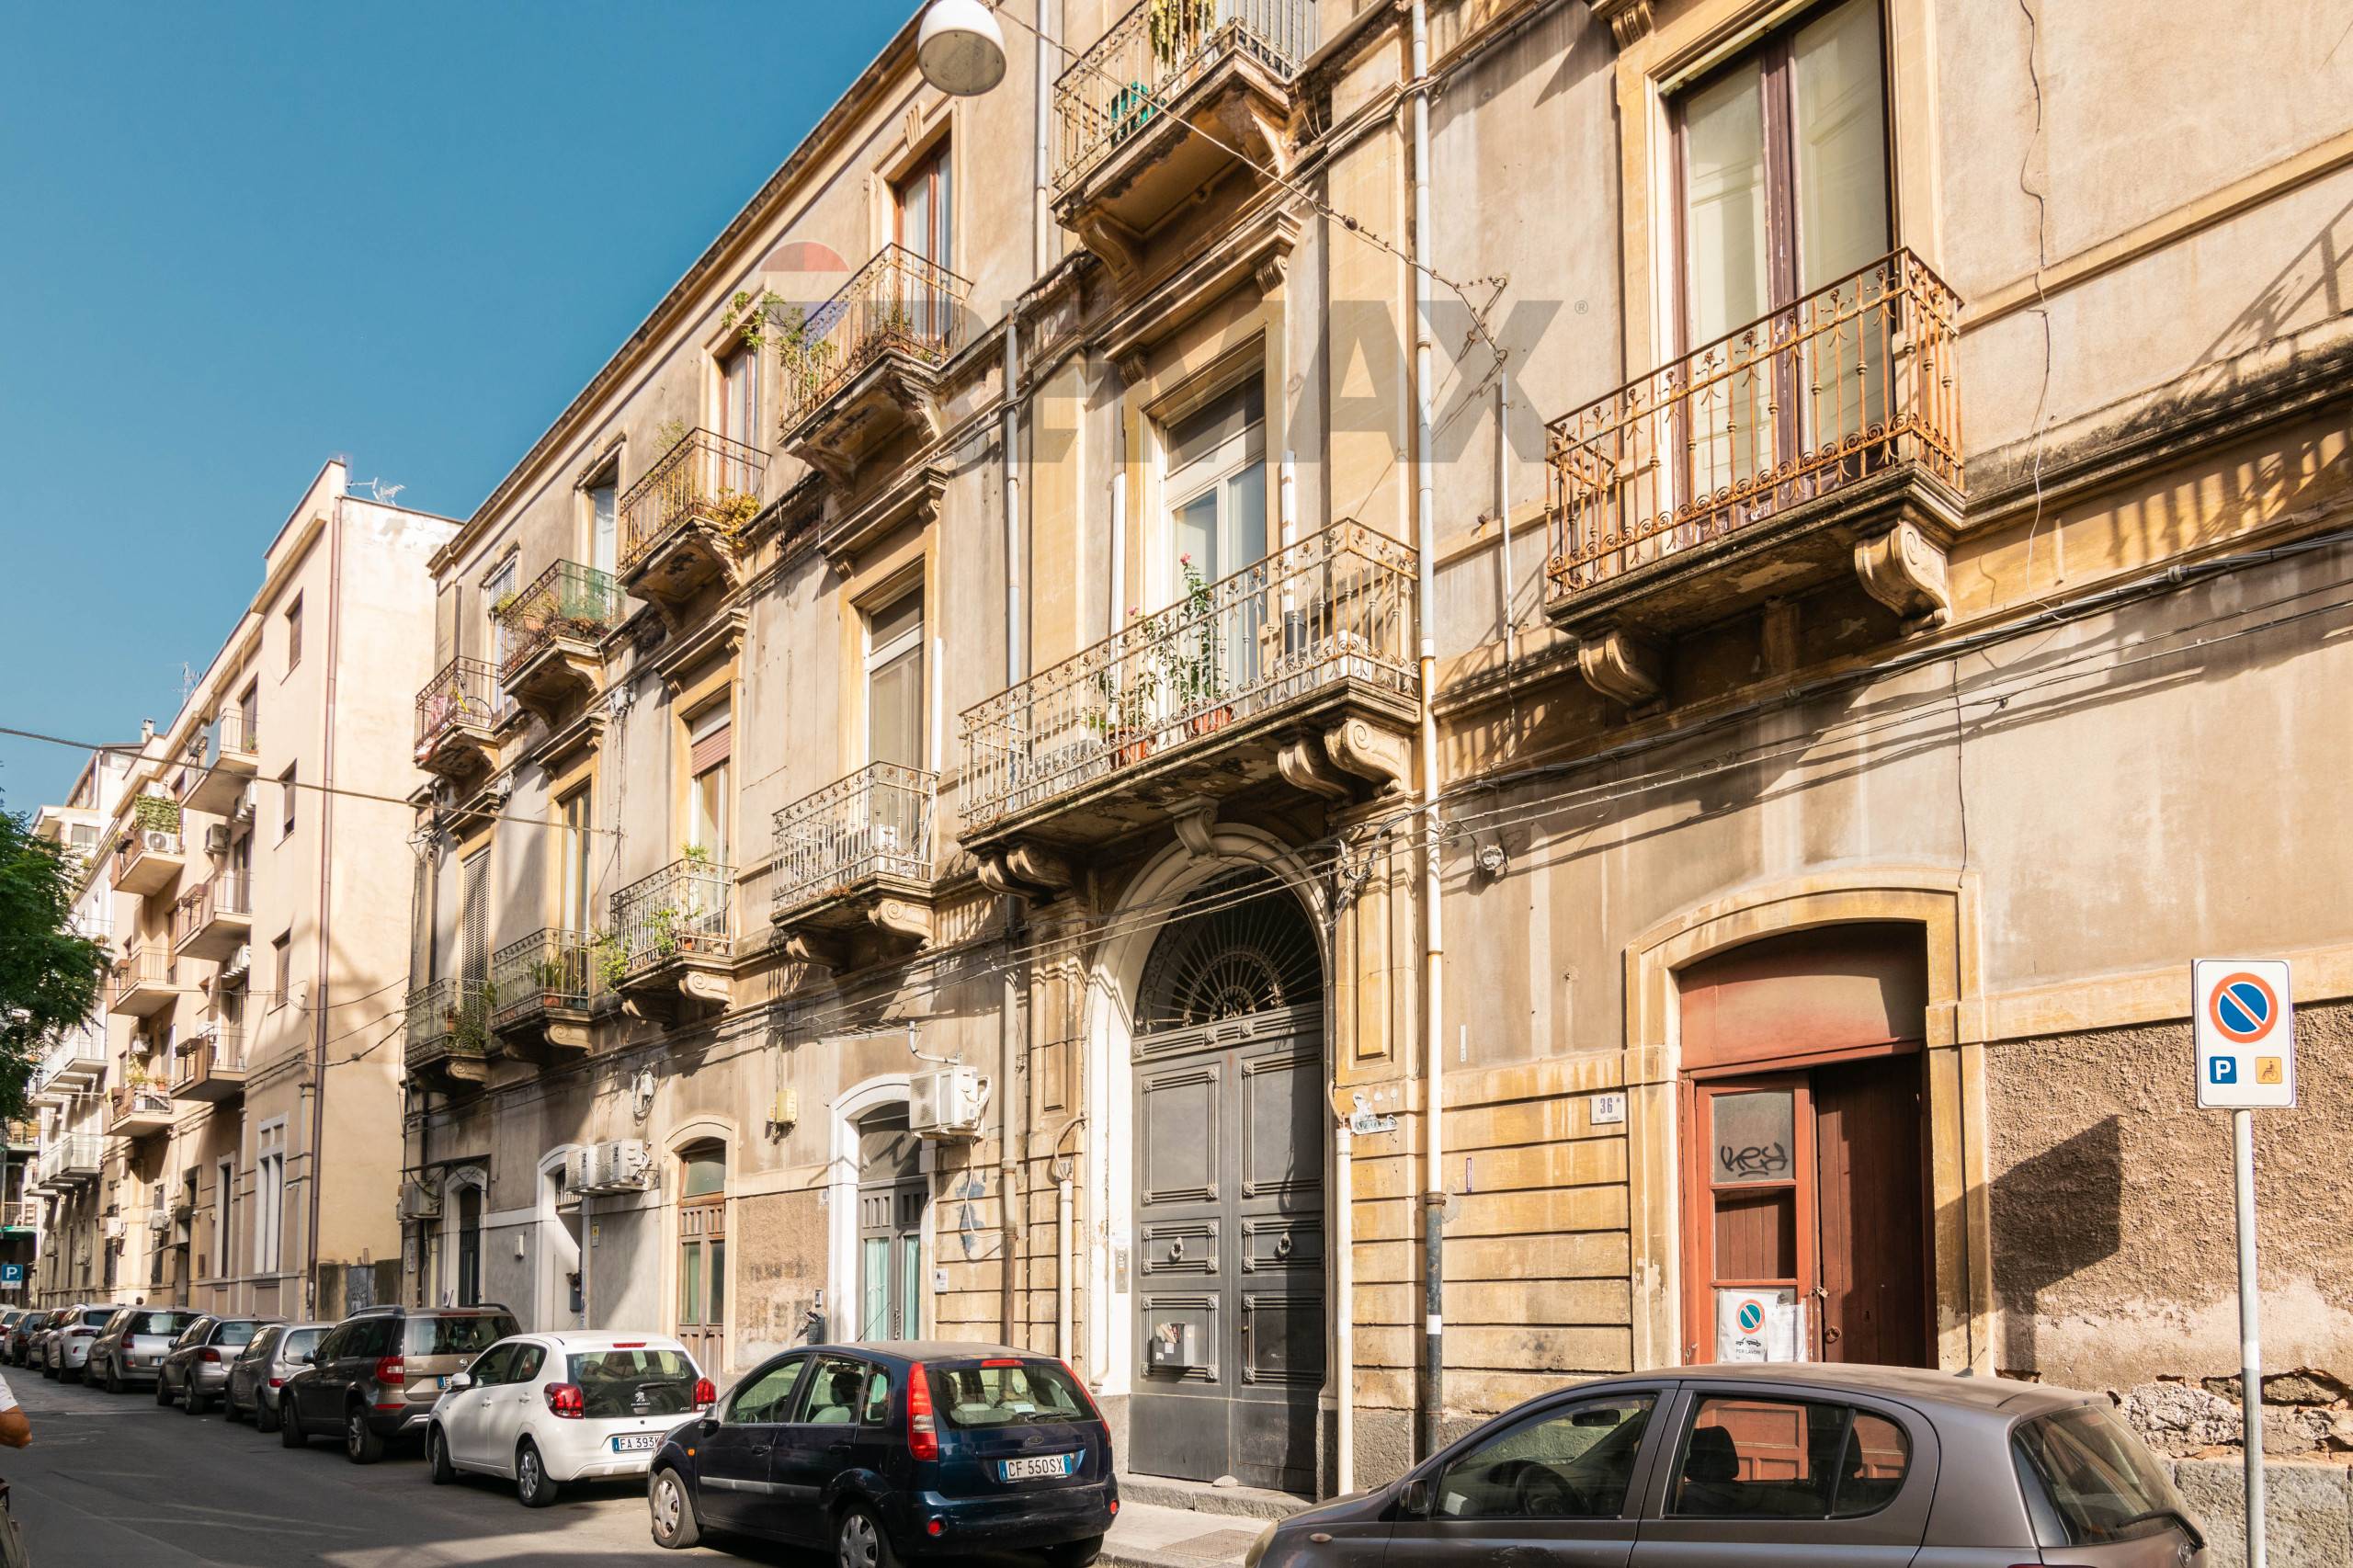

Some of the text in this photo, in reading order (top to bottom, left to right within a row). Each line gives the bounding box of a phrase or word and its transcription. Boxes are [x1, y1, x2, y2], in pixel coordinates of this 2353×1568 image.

[2215, 1059, 2232, 1081] P
[6, 1267, 17, 1278] P
[620, 1437, 632, 1449] FA
[1008, 1458, 1063, 1476] CF 550SX
